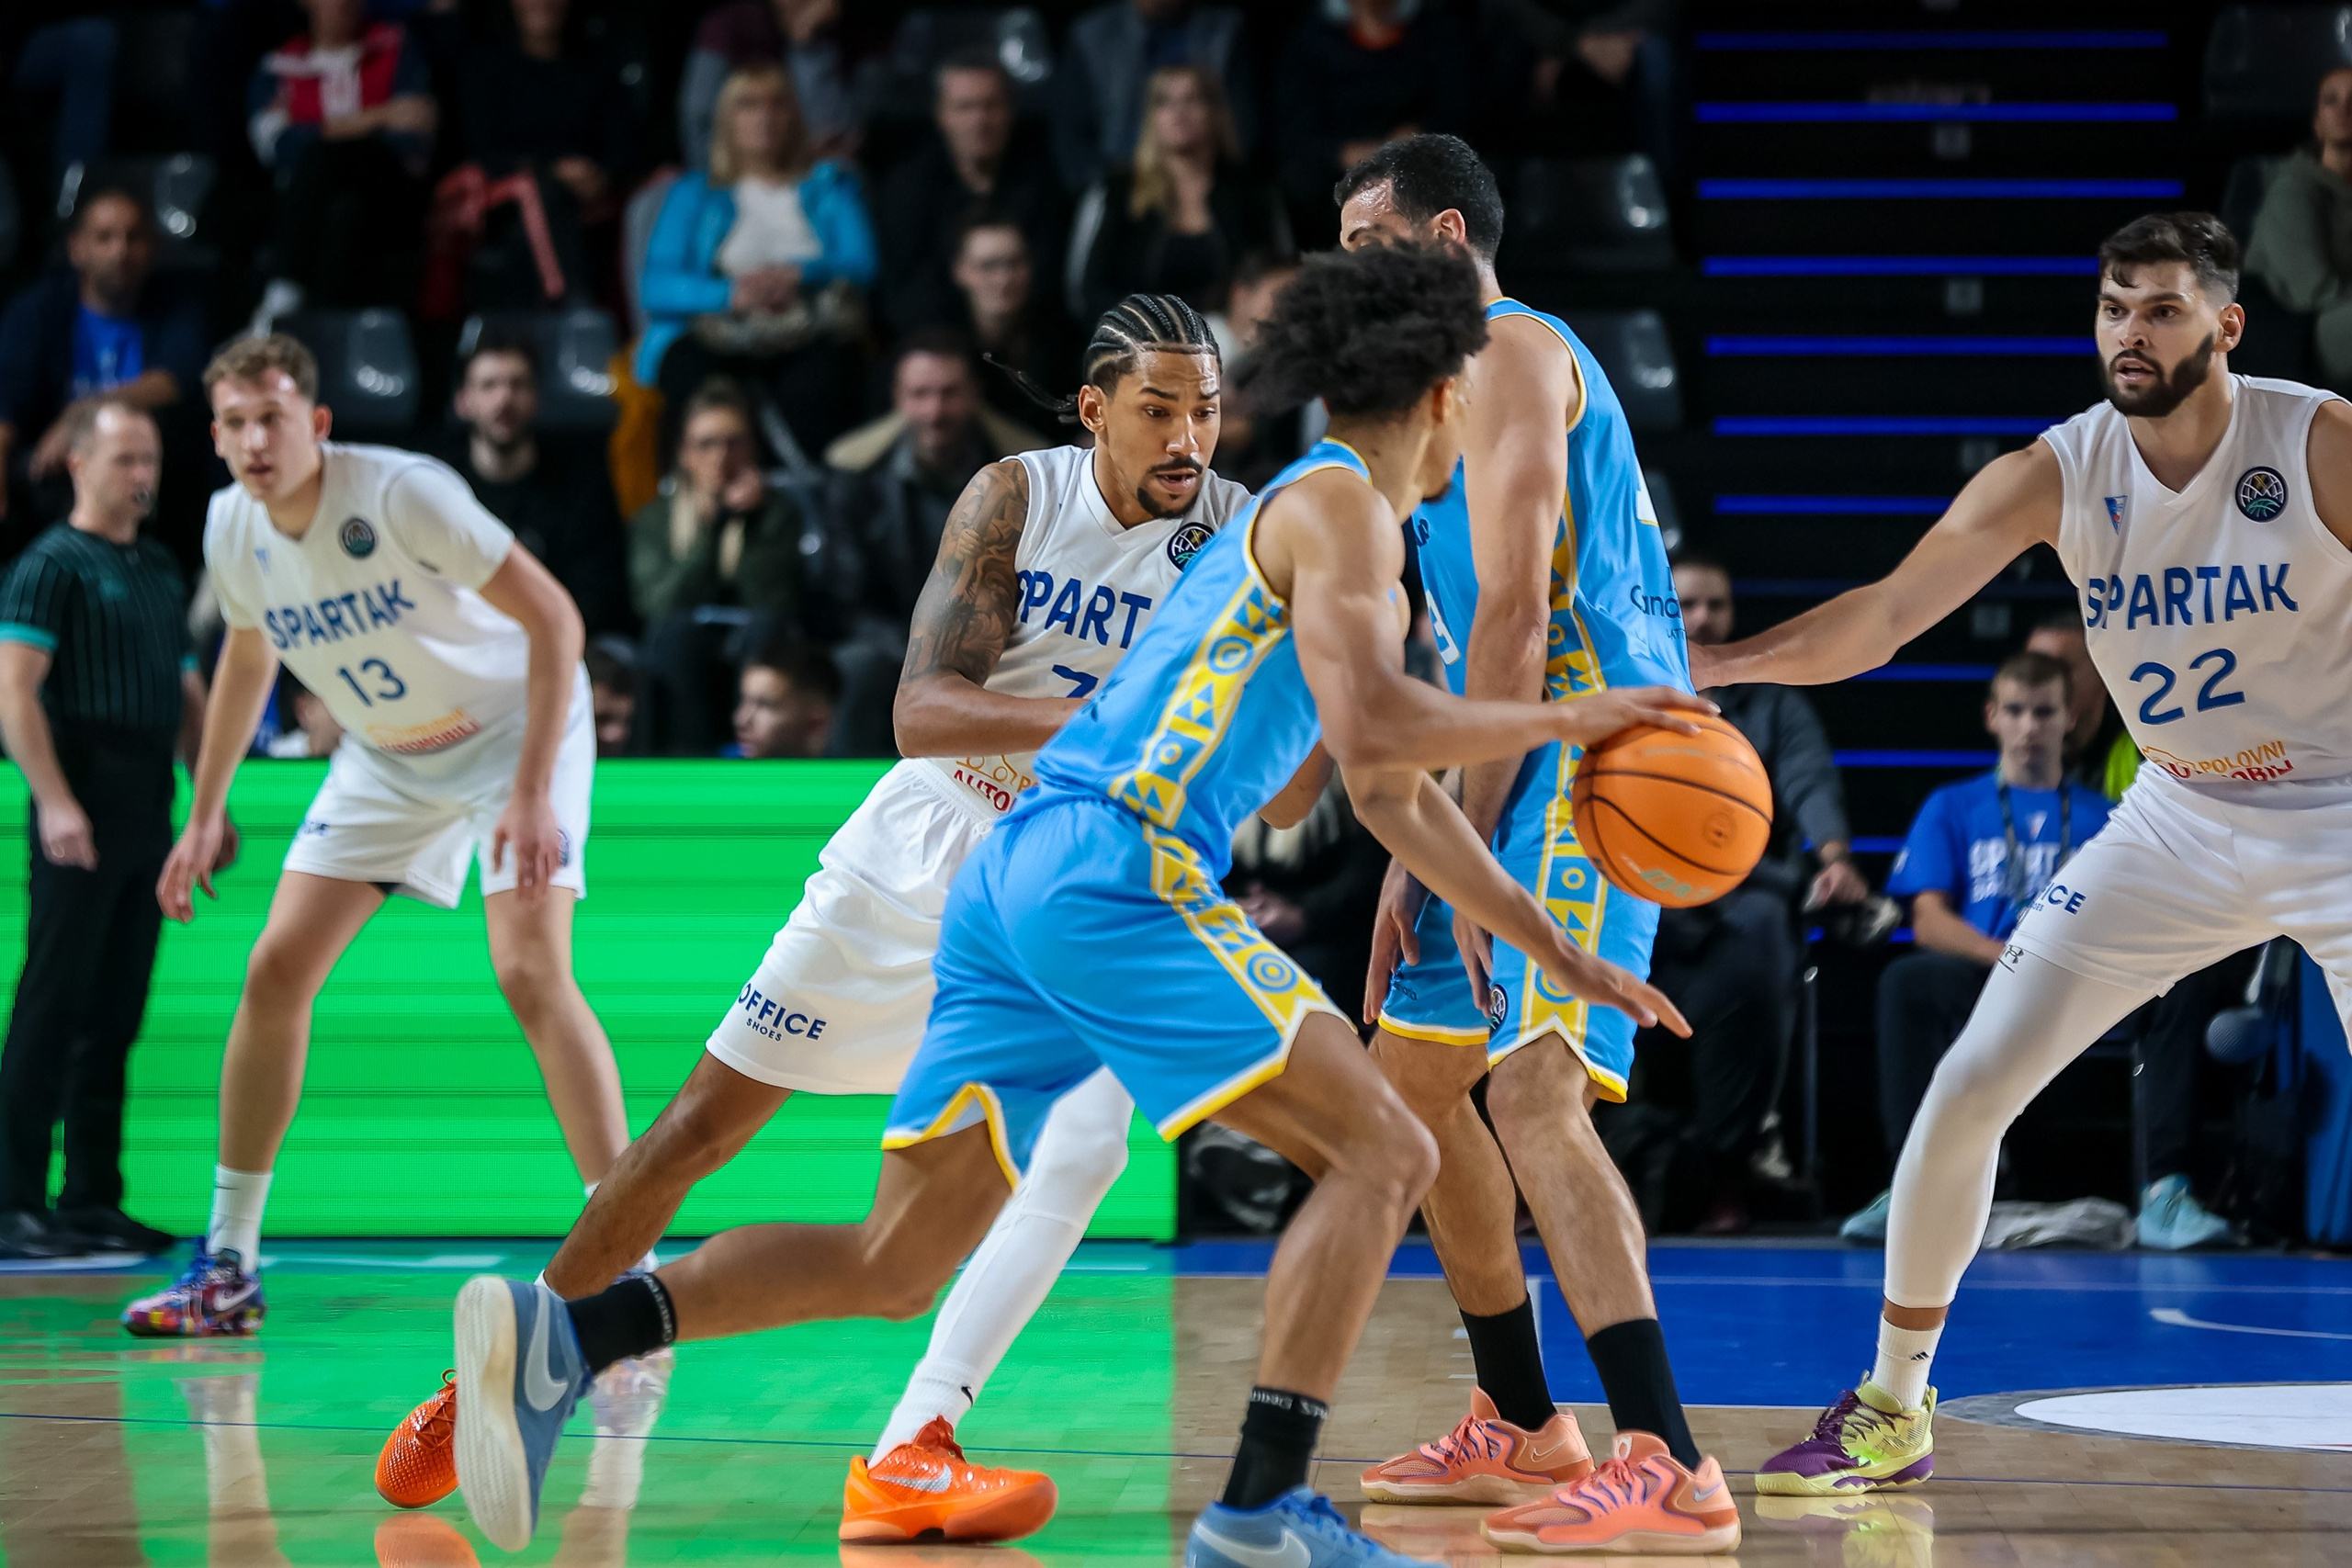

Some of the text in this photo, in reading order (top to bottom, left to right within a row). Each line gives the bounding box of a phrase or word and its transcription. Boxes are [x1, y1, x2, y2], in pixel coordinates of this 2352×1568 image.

[266, 579, 416, 650] SPARTAK
[1017, 569, 1152, 650] PART
[2086, 562, 2299, 631] SPARTAK
[337, 658, 407, 707] 13
[2129, 648, 2246, 726] 22
[2198, 739, 2287, 774] POLOVNI
[738, 982, 828, 1041] OFFICE
[746, 1018, 783, 1043] SHOES
